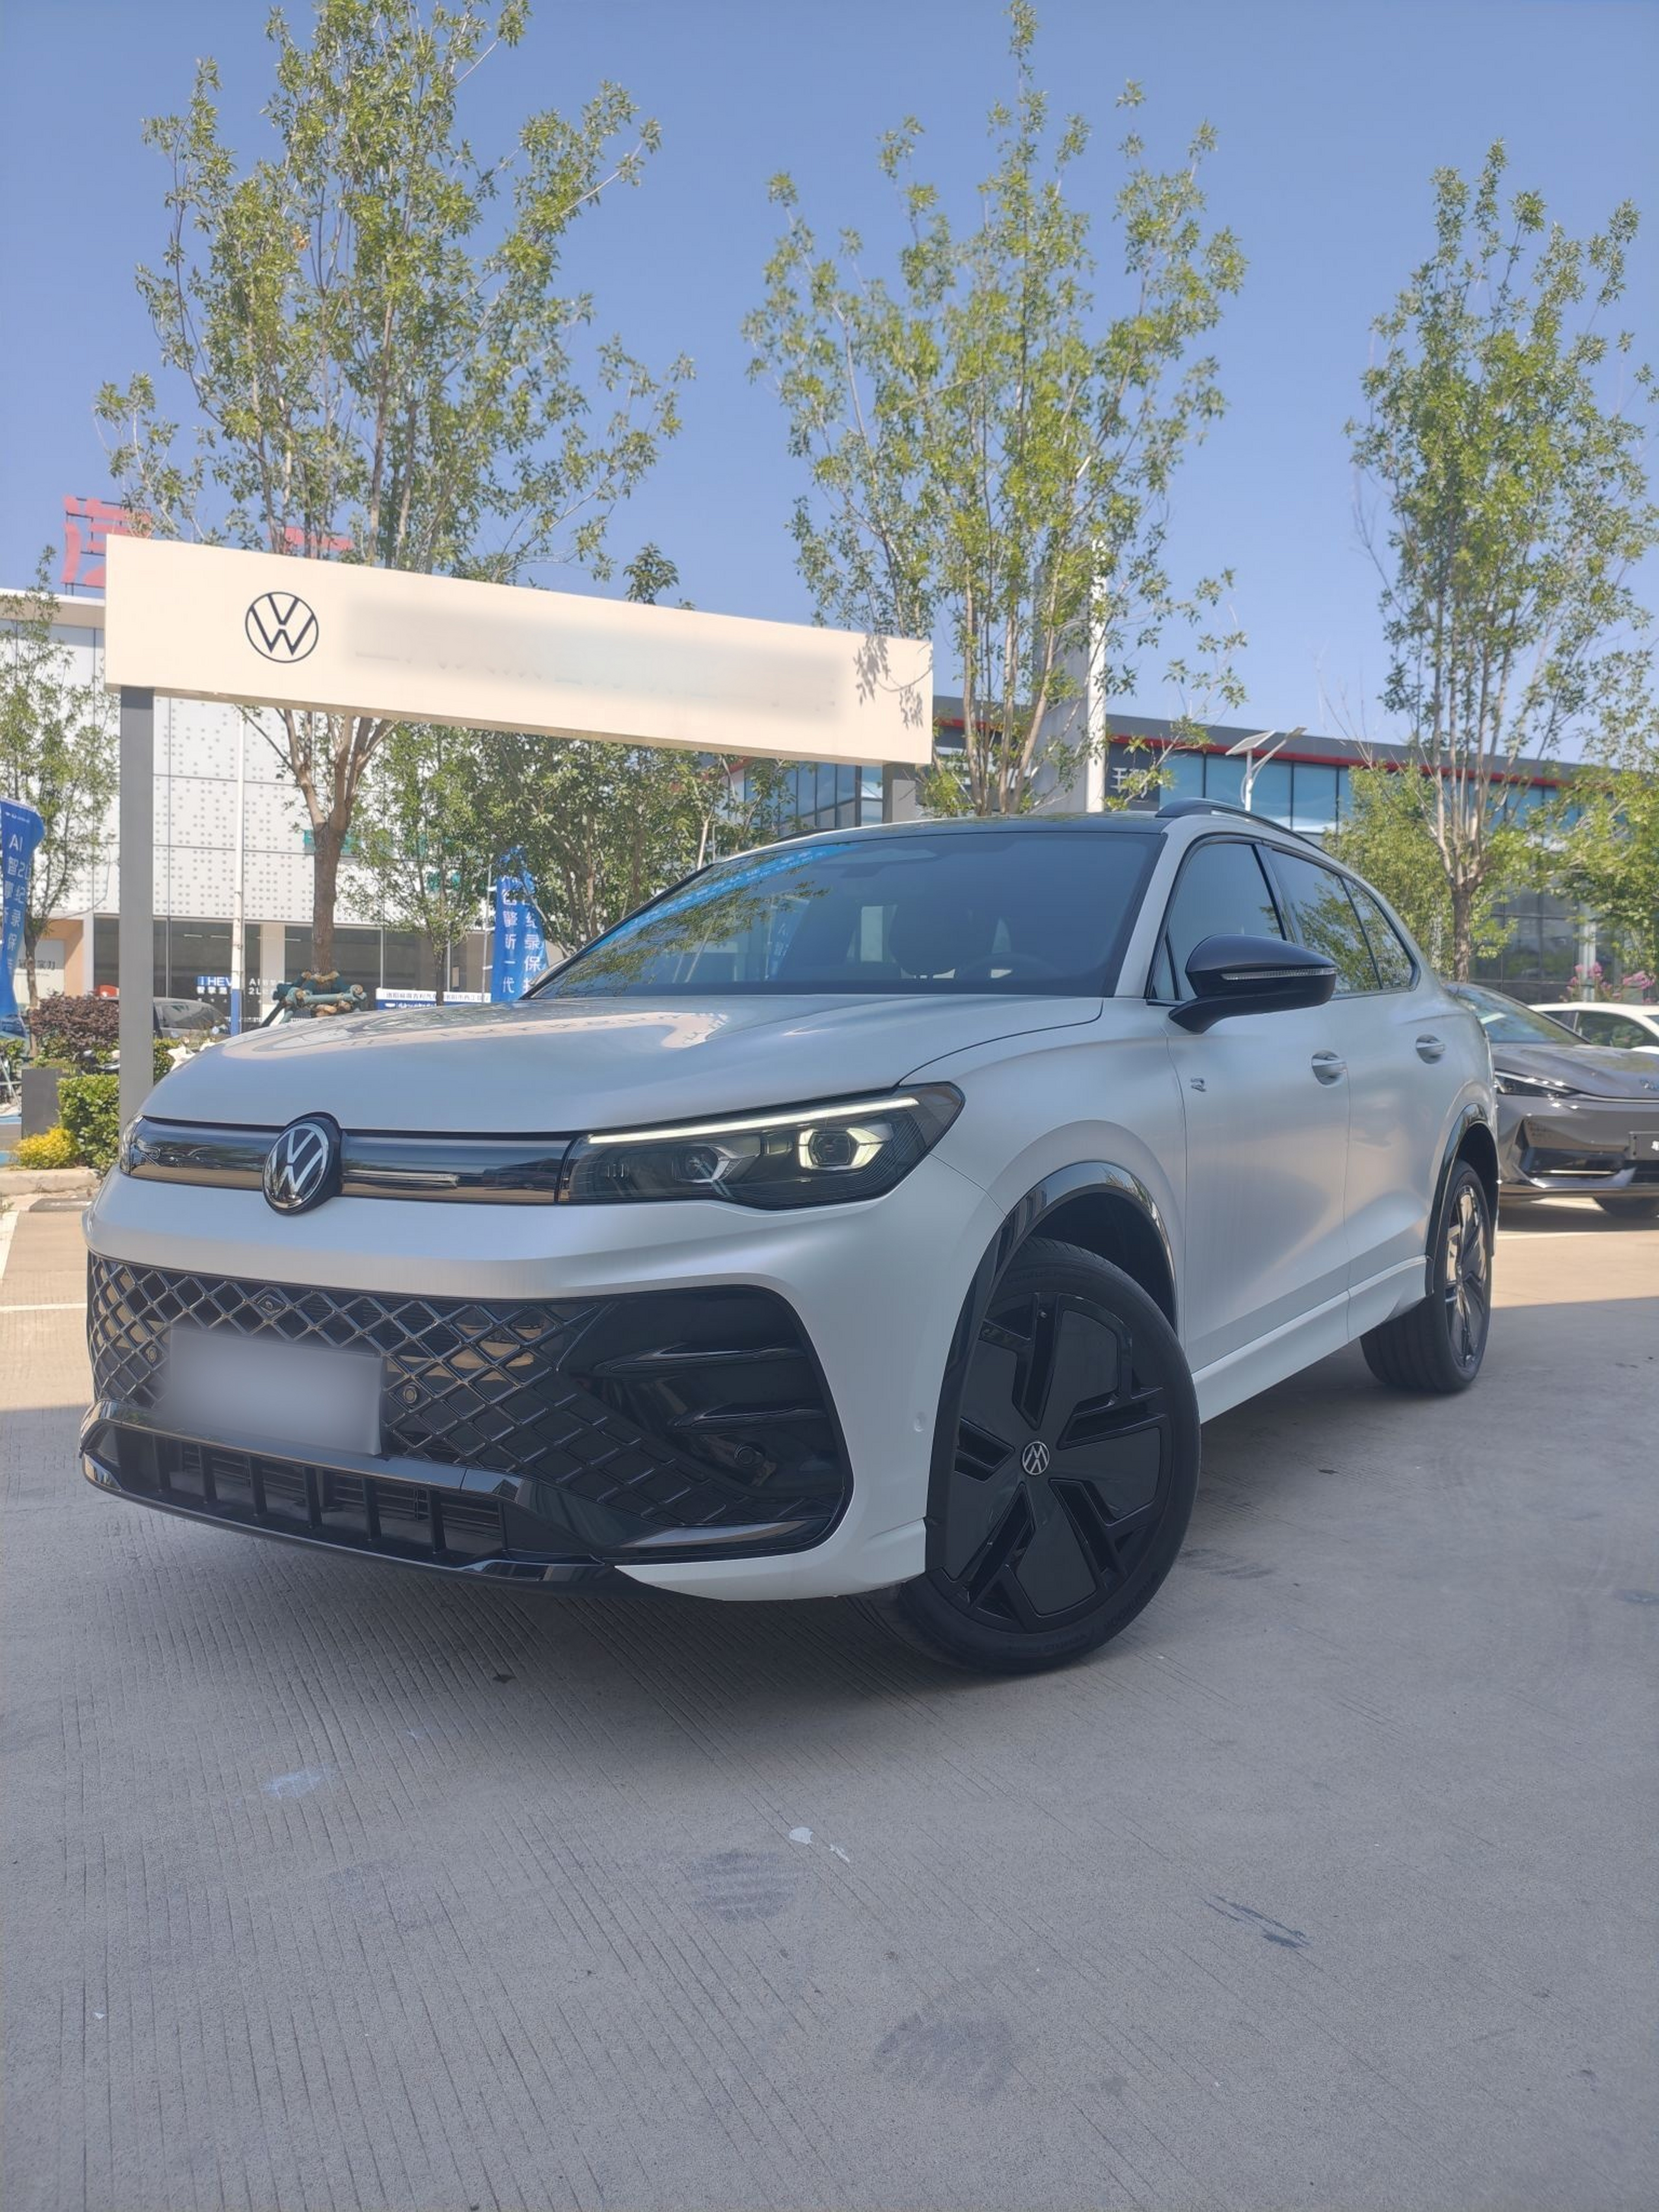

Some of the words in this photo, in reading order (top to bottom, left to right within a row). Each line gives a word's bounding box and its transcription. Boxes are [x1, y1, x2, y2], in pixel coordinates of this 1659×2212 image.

[246, 592, 318, 663] VW
[9, 834, 23, 852] AI
[263, 1123, 329, 1209] VW
